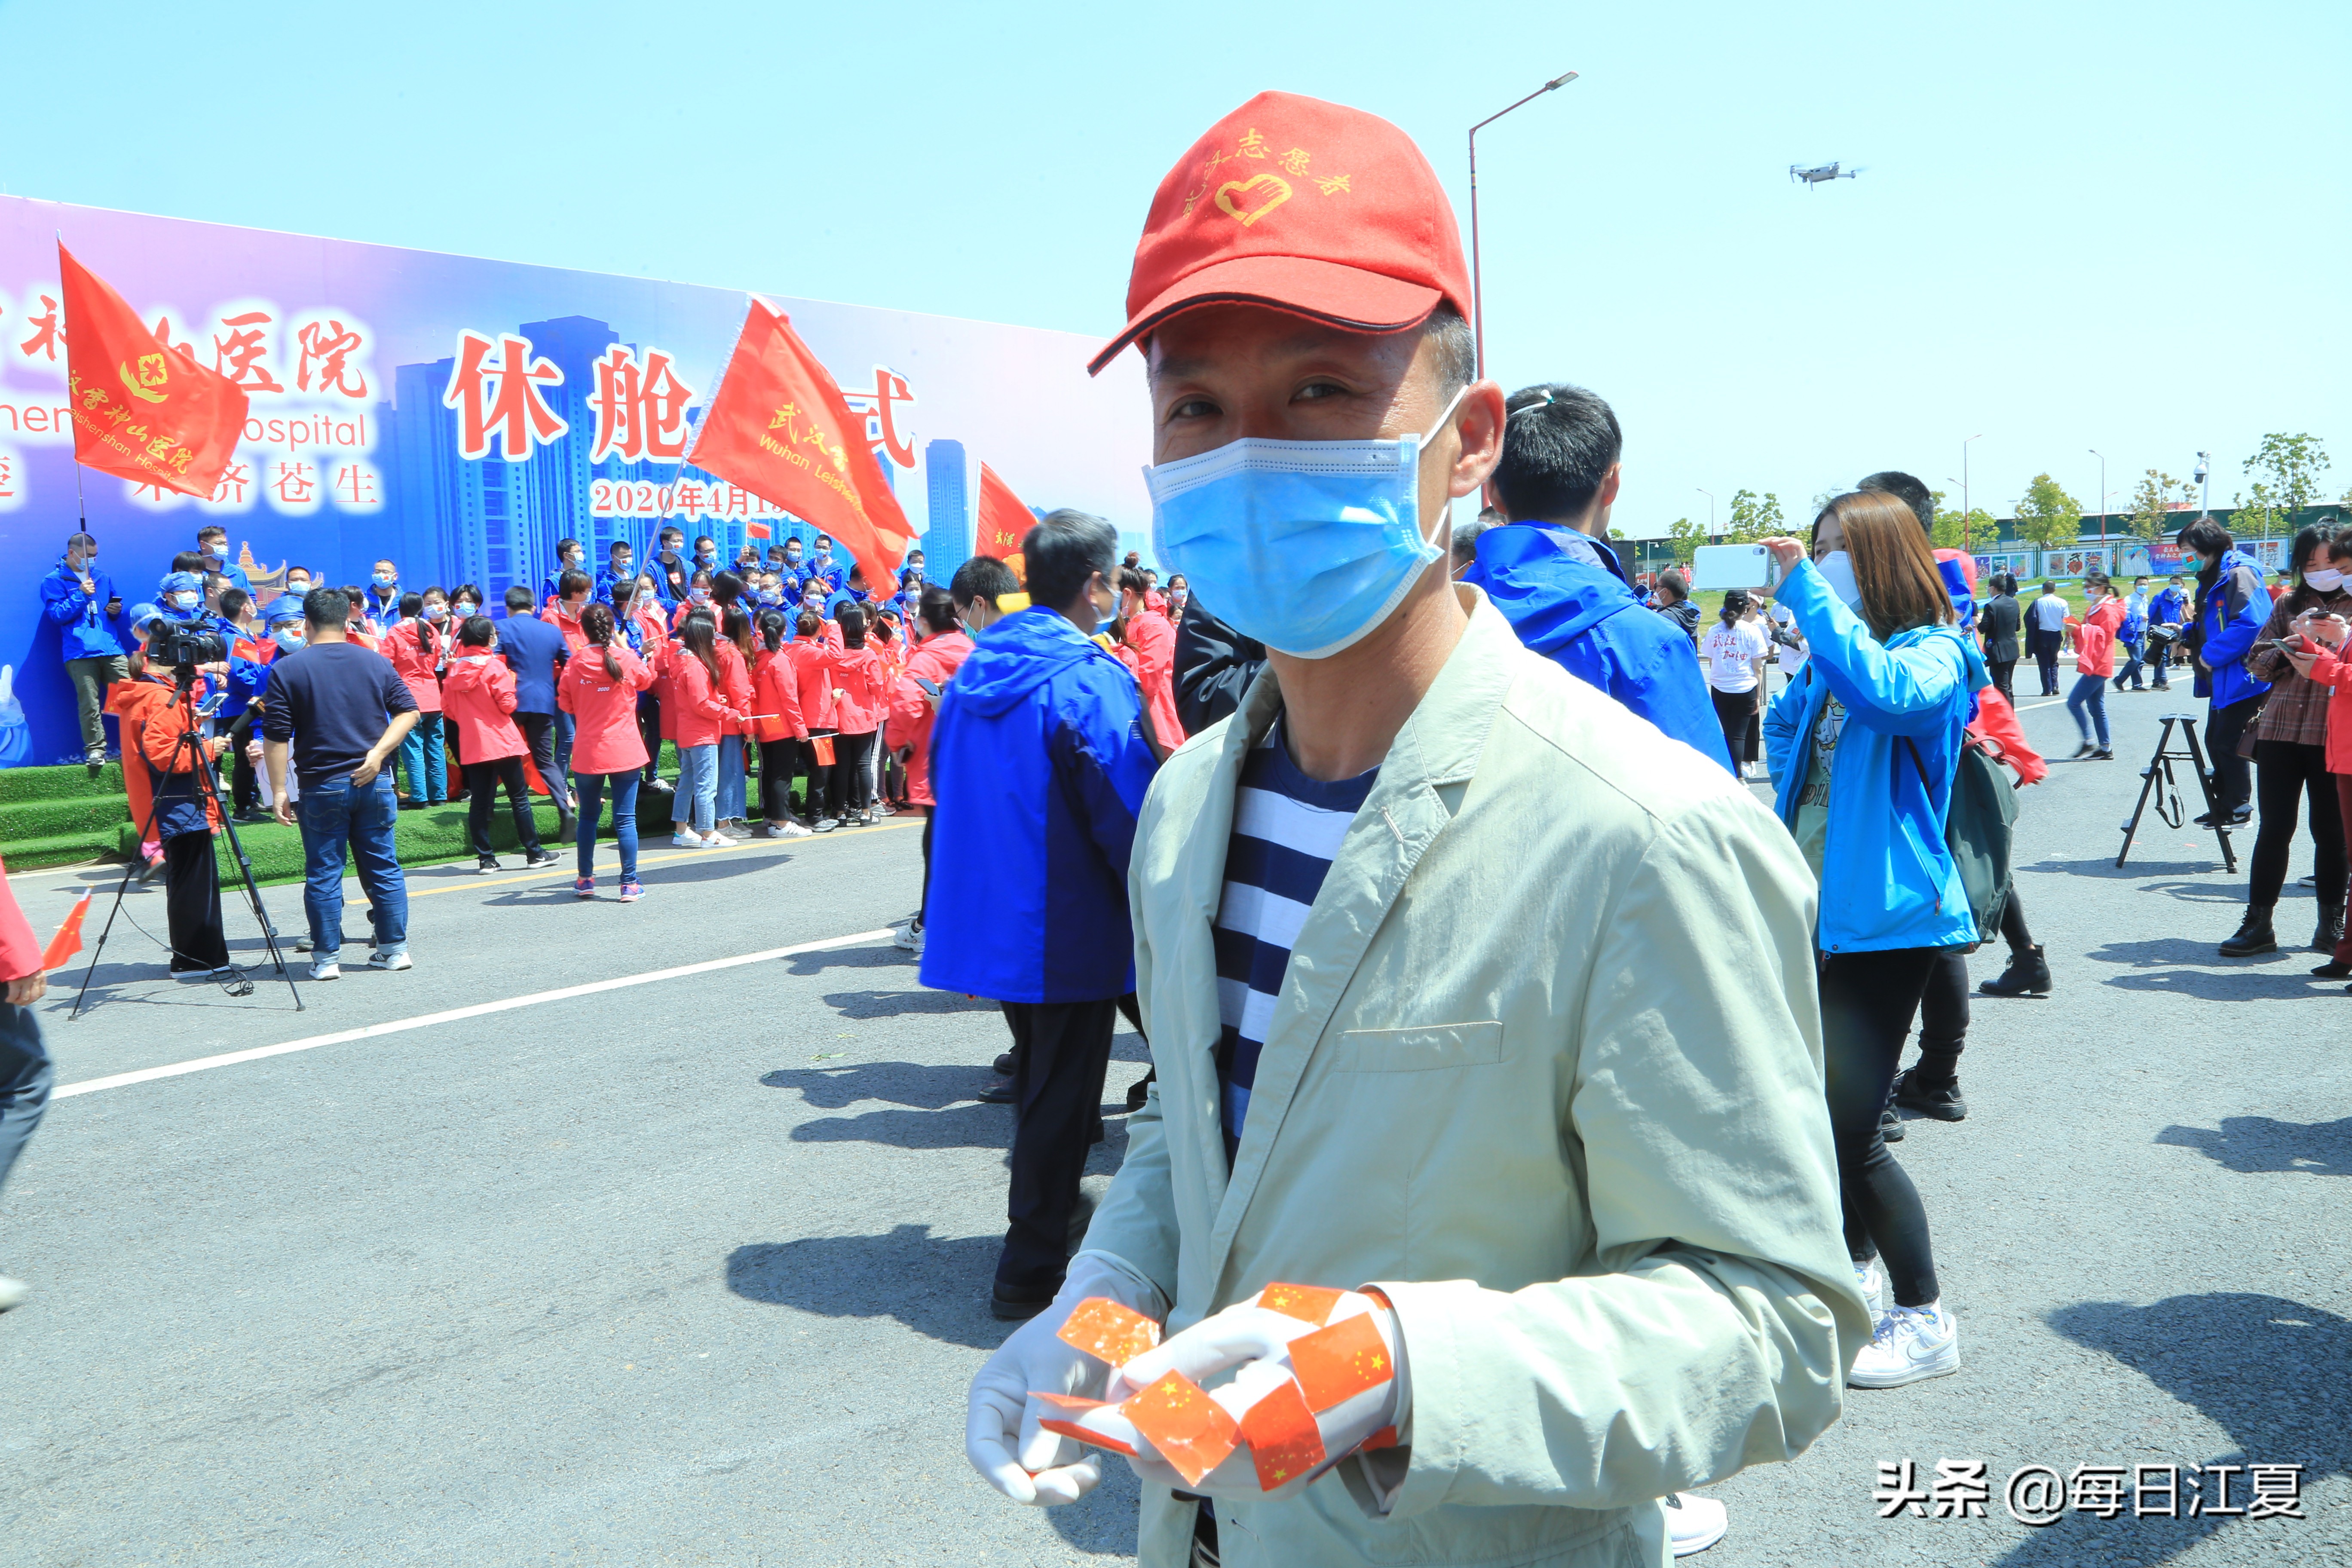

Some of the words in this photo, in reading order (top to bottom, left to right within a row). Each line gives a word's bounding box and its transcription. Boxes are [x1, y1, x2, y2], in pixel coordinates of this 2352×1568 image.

[242, 413, 365, 452] ospital
[759, 433, 810, 470] Wuhan
[1713, 634, 1736, 647] 武汉
[1722, 650, 1748, 661] 加油
